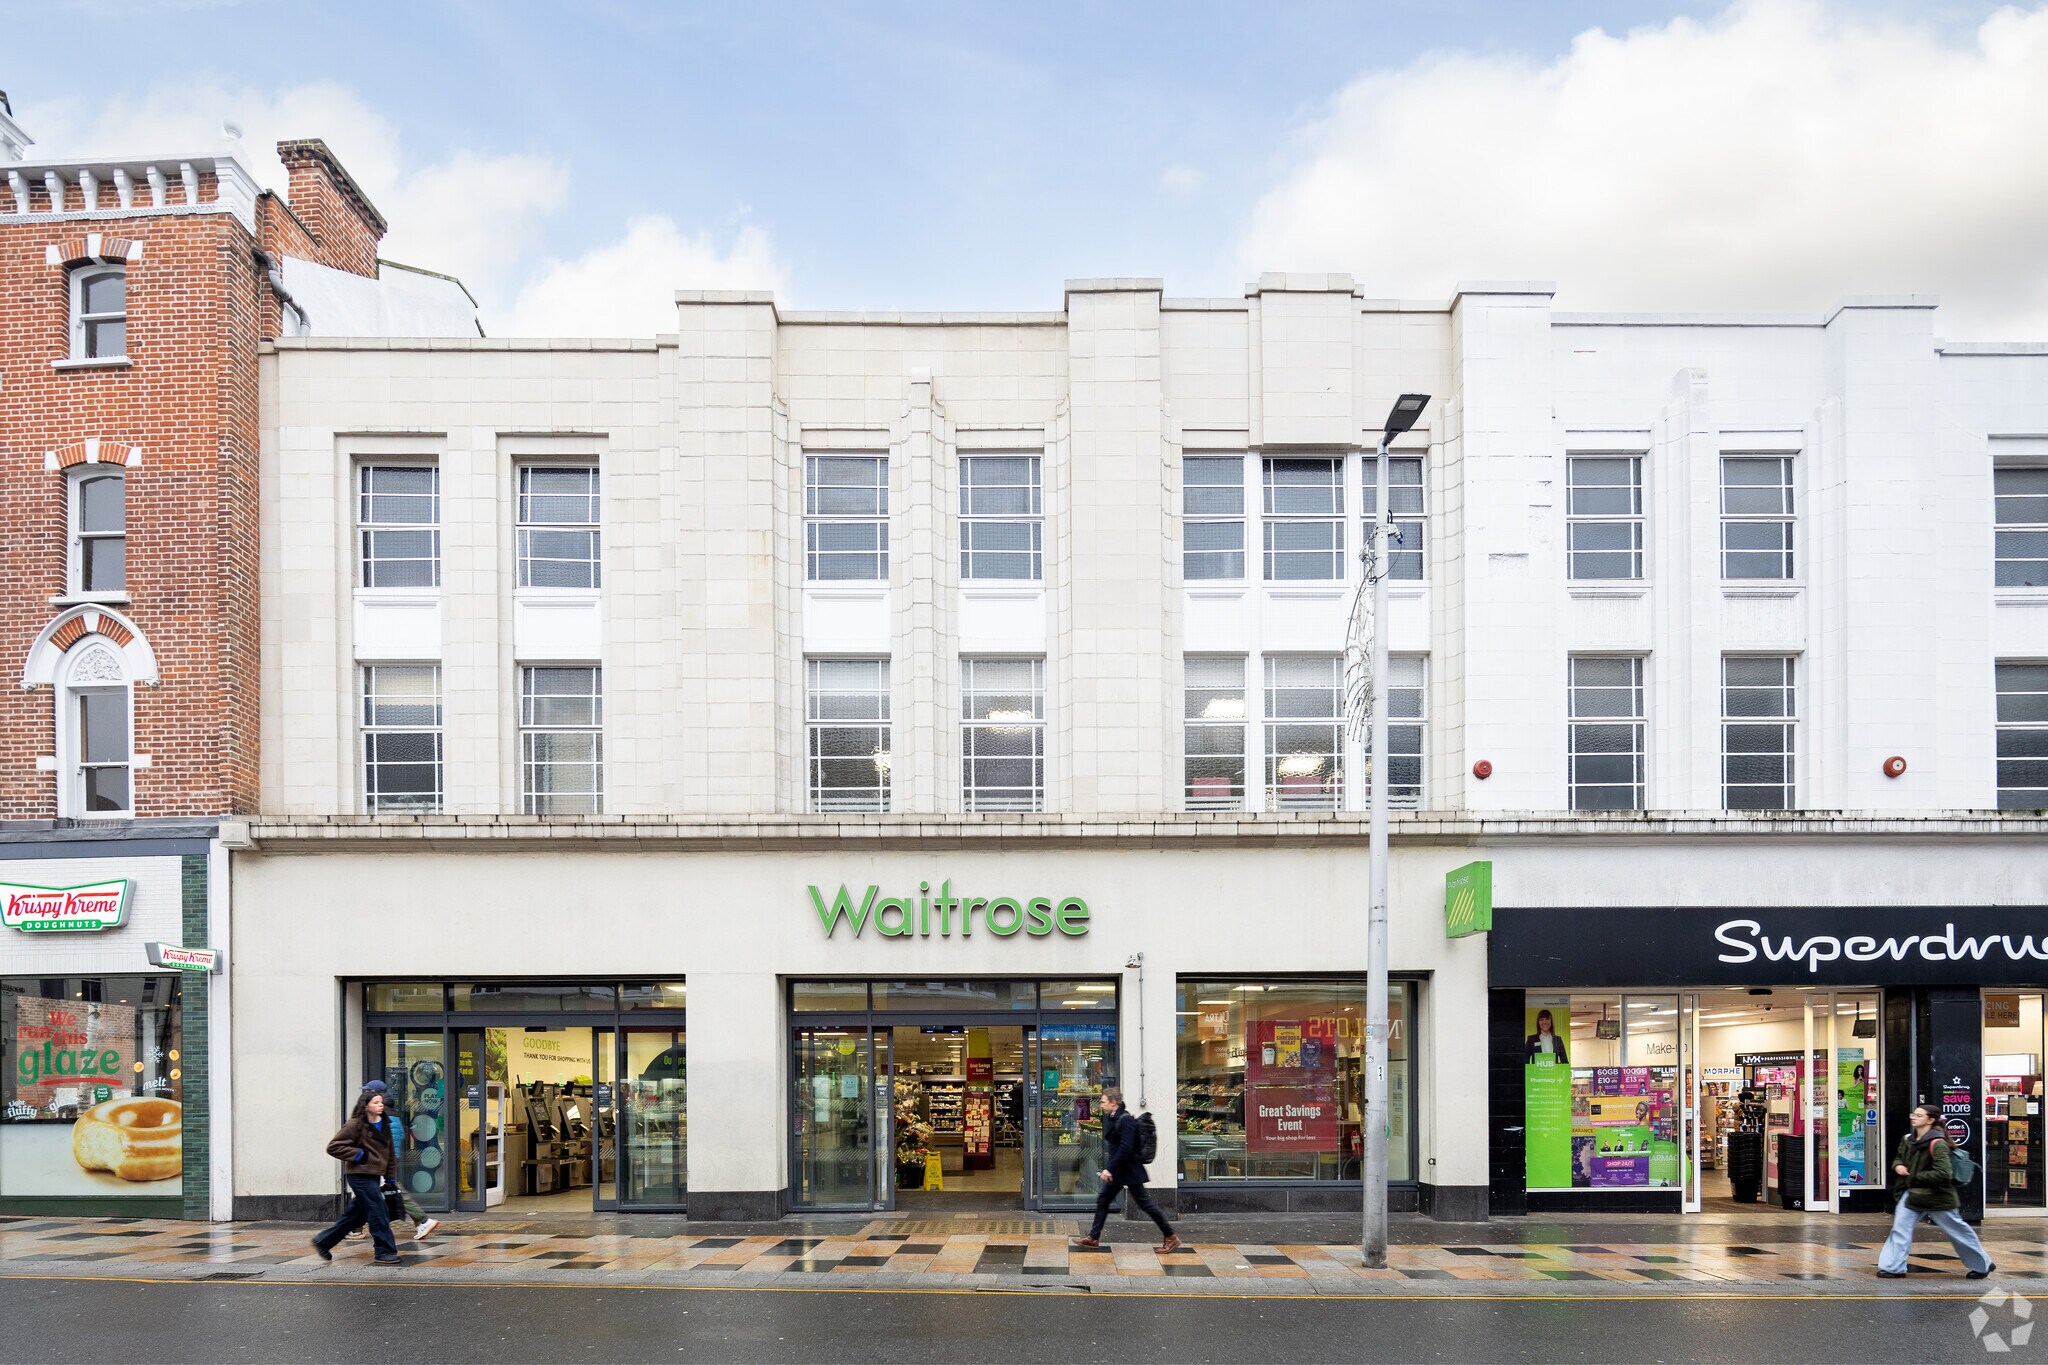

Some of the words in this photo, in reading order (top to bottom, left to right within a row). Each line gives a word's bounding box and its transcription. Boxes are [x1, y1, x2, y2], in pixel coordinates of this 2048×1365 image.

[7, 892, 64, 919] Krispy
[64, 891, 119, 915] Kreme
[807, 877, 1090, 939] Waitrose
[26, 921, 97, 929] DOUGHNUTS
[1715, 919, 2048, 973] Superdru
[163, 948, 190, 964] Krispy
[189, 951, 213, 963] Kreme
[50, 1011, 77, 1027] We
[1997, 1011, 2018, 1019] HERE
[18, 1025, 51, 1039] run
[52, 1028, 88, 1045] this
[523, 1037, 561, 1051] GOODBYE
[18, 1041, 120, 1085] glaze
[557, 1055, 576, 1063] SHOPPING
[1536, 1060, 1555, 1068] HUB
[1743, 1055, 1761, 1063] NYX
[1597, 1068, 1618, 1076] 60GB
[1622, 1067, 1647, 1075] 100GB
[1704, 1067, 1741, 1075] MORPHE
[143, 1077, 167, 1091] melt
[8, 1099, 26, 1108] Light
[1943, 1094, 1971, 1103] save
[7, 1104, 38, 1120] fluffy
[1259, 1105, 1284, 1118] Great
[1285, 1104, 1321, 1119] Savings
[1942, 1104, 1971, 1113] more
[1278, 1118, 1303, 1131] Event
